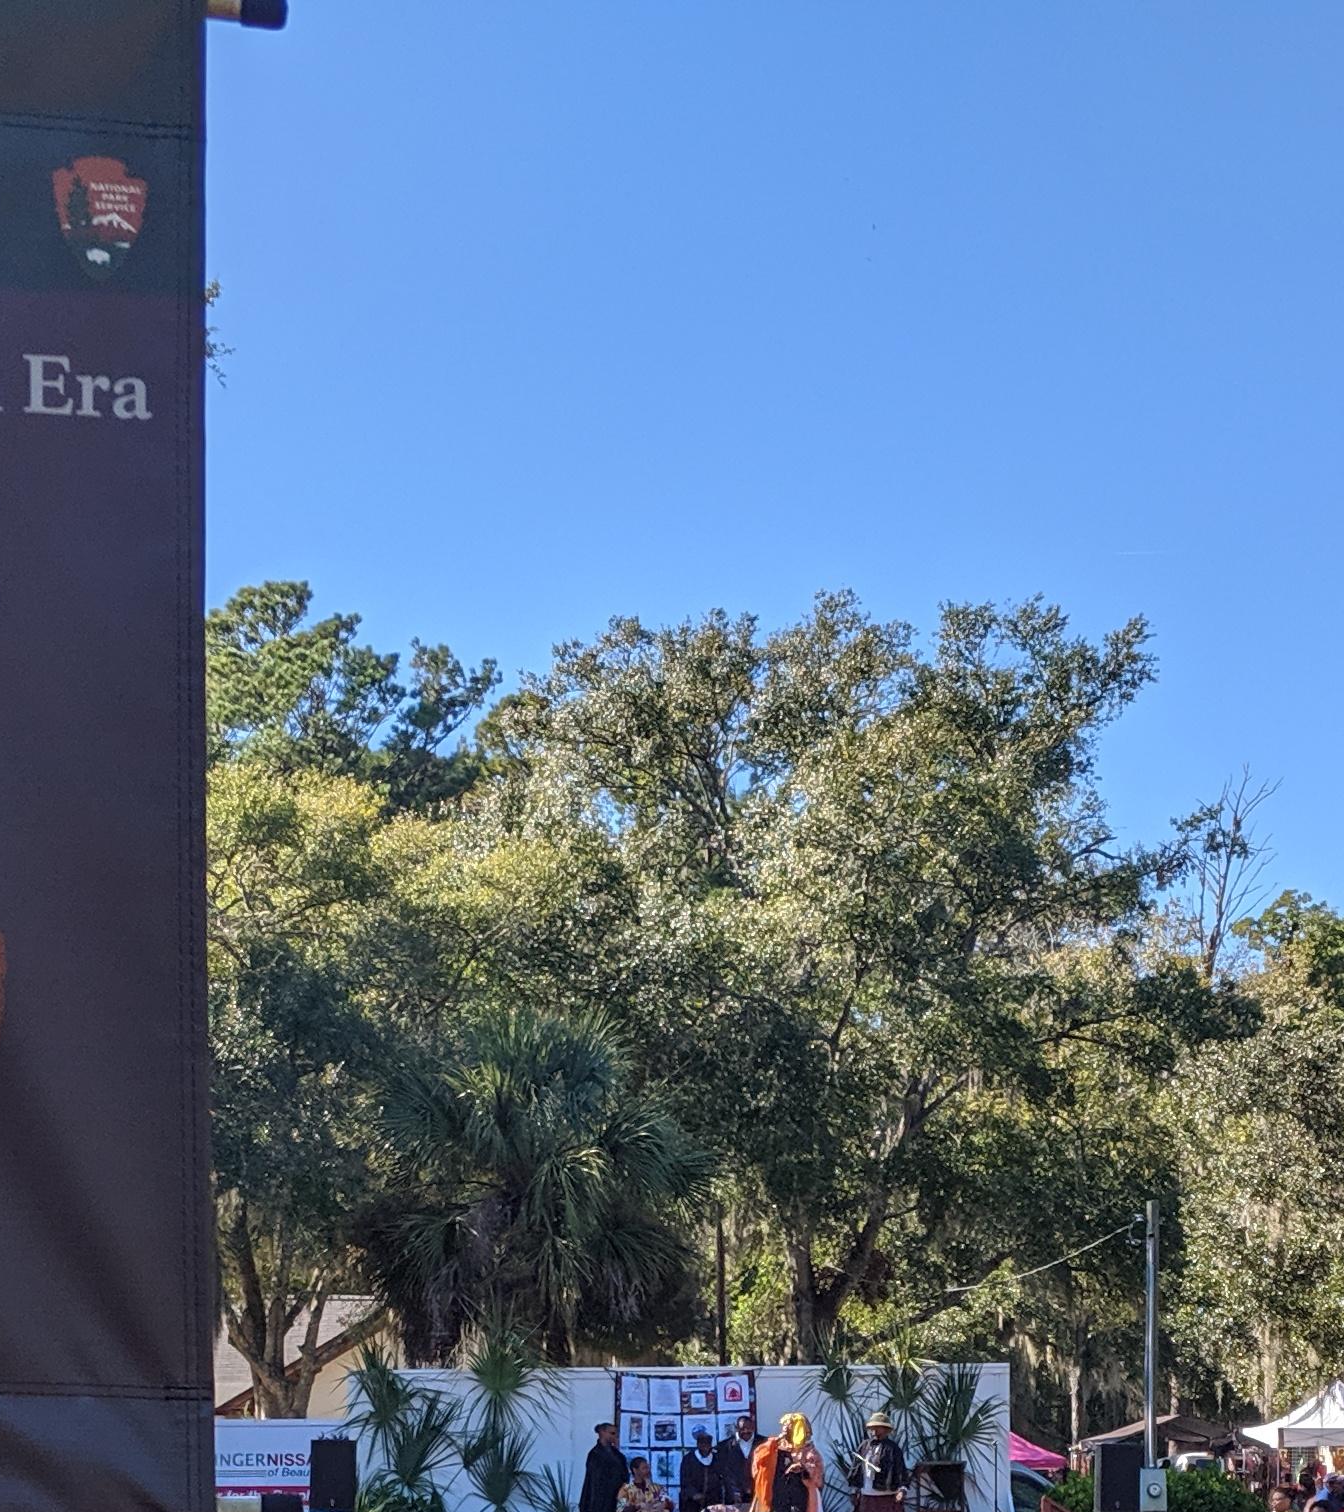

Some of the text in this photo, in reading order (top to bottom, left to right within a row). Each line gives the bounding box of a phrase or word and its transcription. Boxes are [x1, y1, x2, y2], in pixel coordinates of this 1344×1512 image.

[89, 181, 141, 195] NATIONAL
[102, 192, 128, 201] PARK
[96, 201, 136, 213] SERVICE
[22, 354, 152, 420] Era
